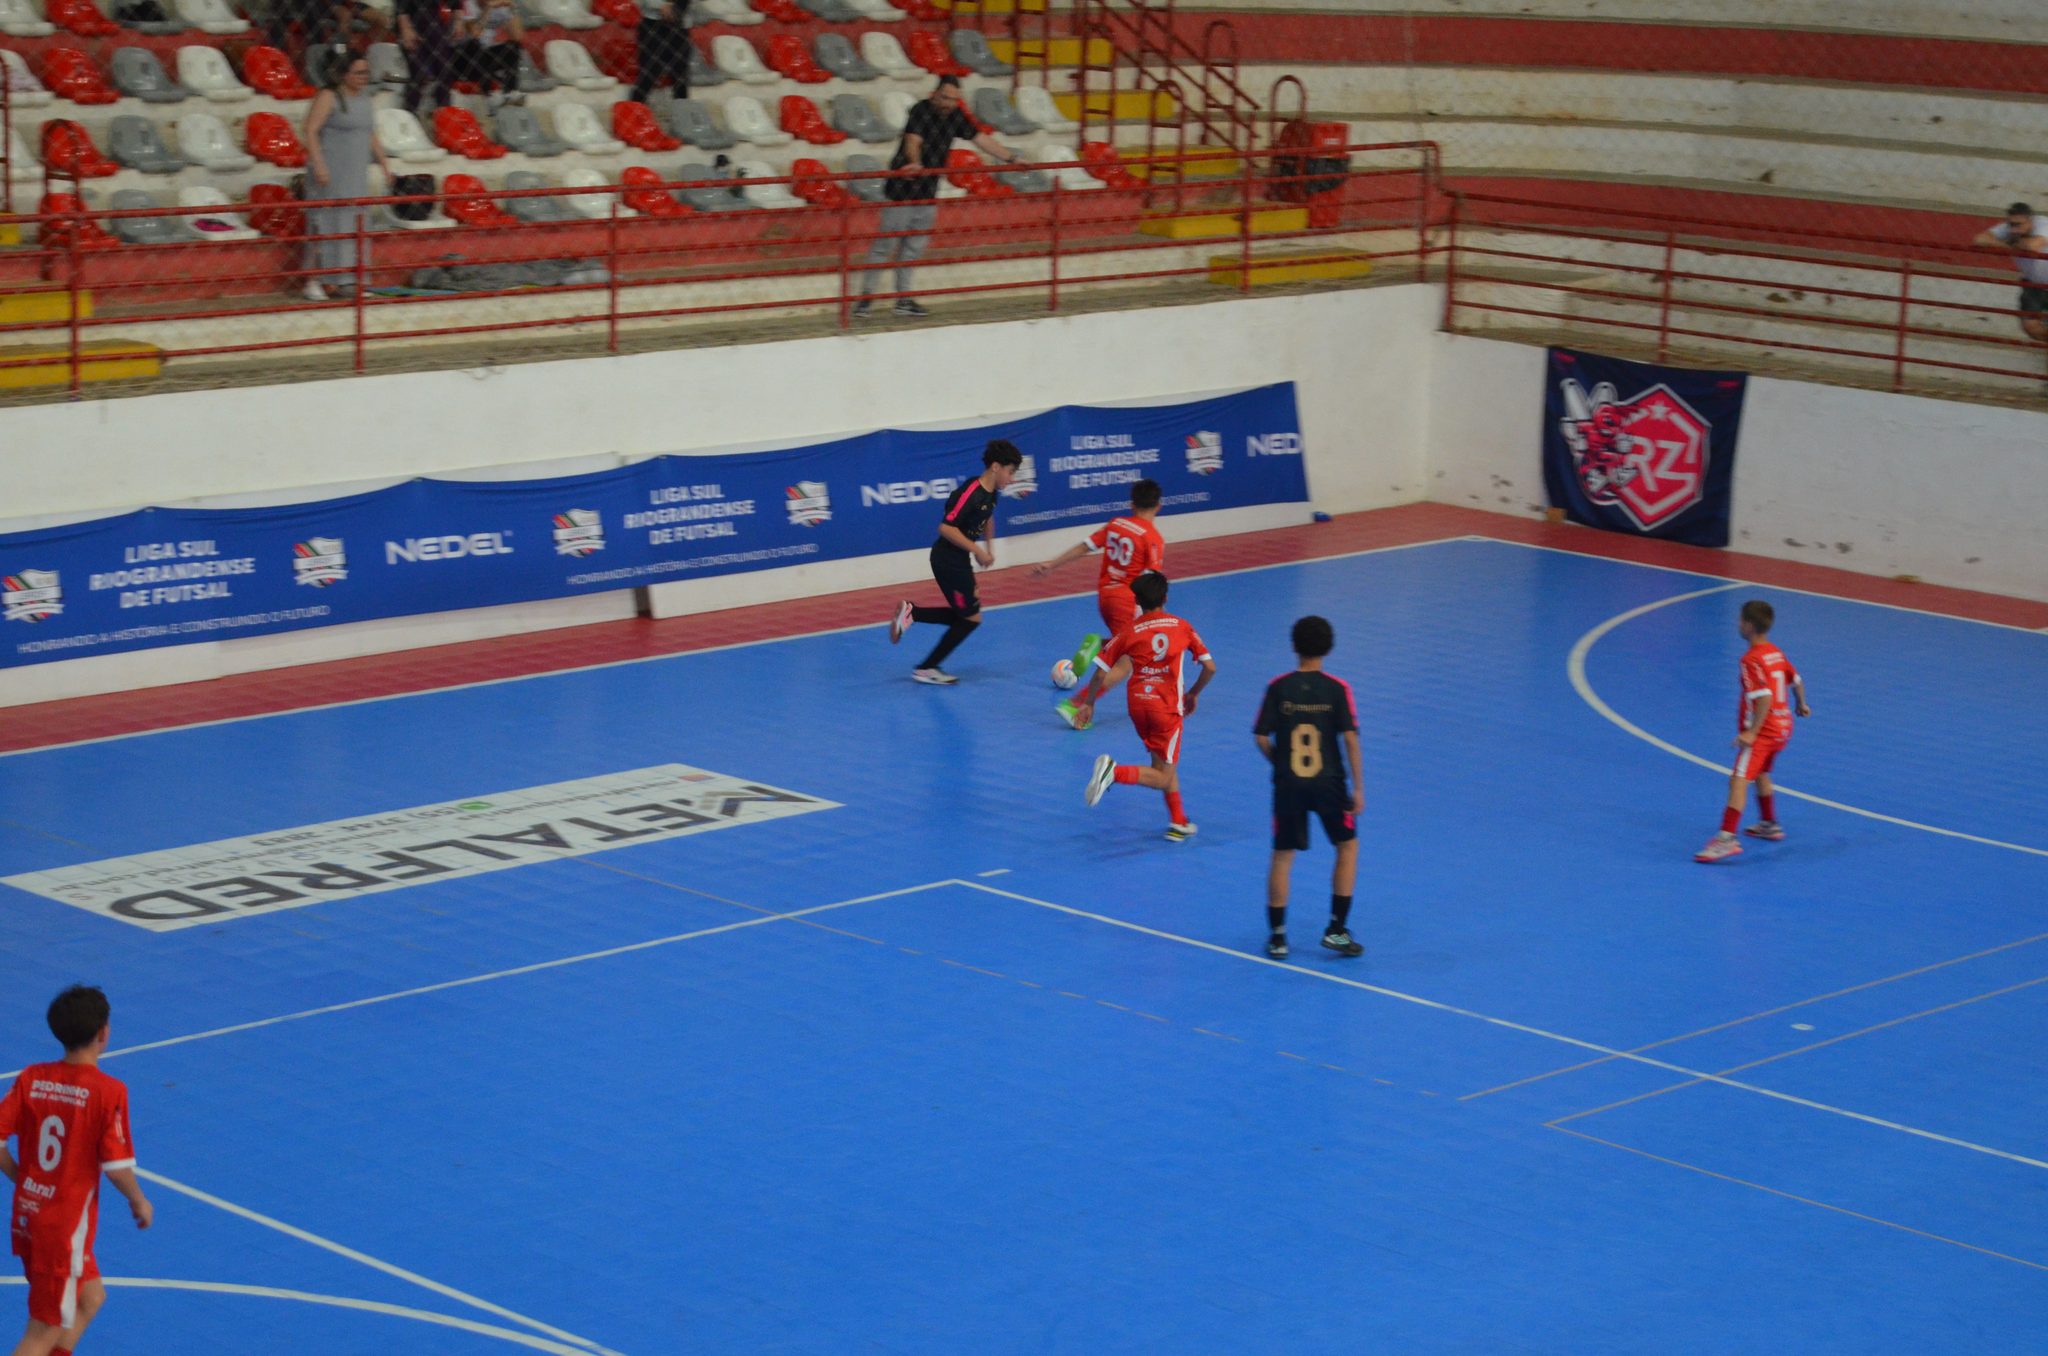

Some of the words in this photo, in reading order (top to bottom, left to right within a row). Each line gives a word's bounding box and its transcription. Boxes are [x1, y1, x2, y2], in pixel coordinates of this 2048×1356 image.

[1070, 435, 1105, 450] LIGA
[1105, 434, 1136, 448] SUL
[1049, 448, 1160, 473] RIOGRANDENSE
[1069, 474, 1091, 489] DE
[1090, 468, 1144, 487] FUTSAL
[650, 486, 691, 505] LIGA
[690, 484, 726, 500] SUL
[623, 499, 756, 529] RIOGRANDENSE
[649, 528, 674, 545] DE
[674, 521, 738, 543] FUTSAL
[124, 542, 177, 563] LIGA
[177, 540, 221, 558] SUL
[385, 532, 514, 565] NEDEL
[89, 557, 256, 591] RIOGRANDENSE
[119, 590, 151, 609] DE
[151, 581, 233, 605] FUTSAL
[1152, 633, 1169, 661] 9
[1771, 670, 1786, 702] 1
[1291, 723, 1323, 778] 8
[109, 786, 819, 920] METALFRED
[38, 1115, 66, 1172] 6
